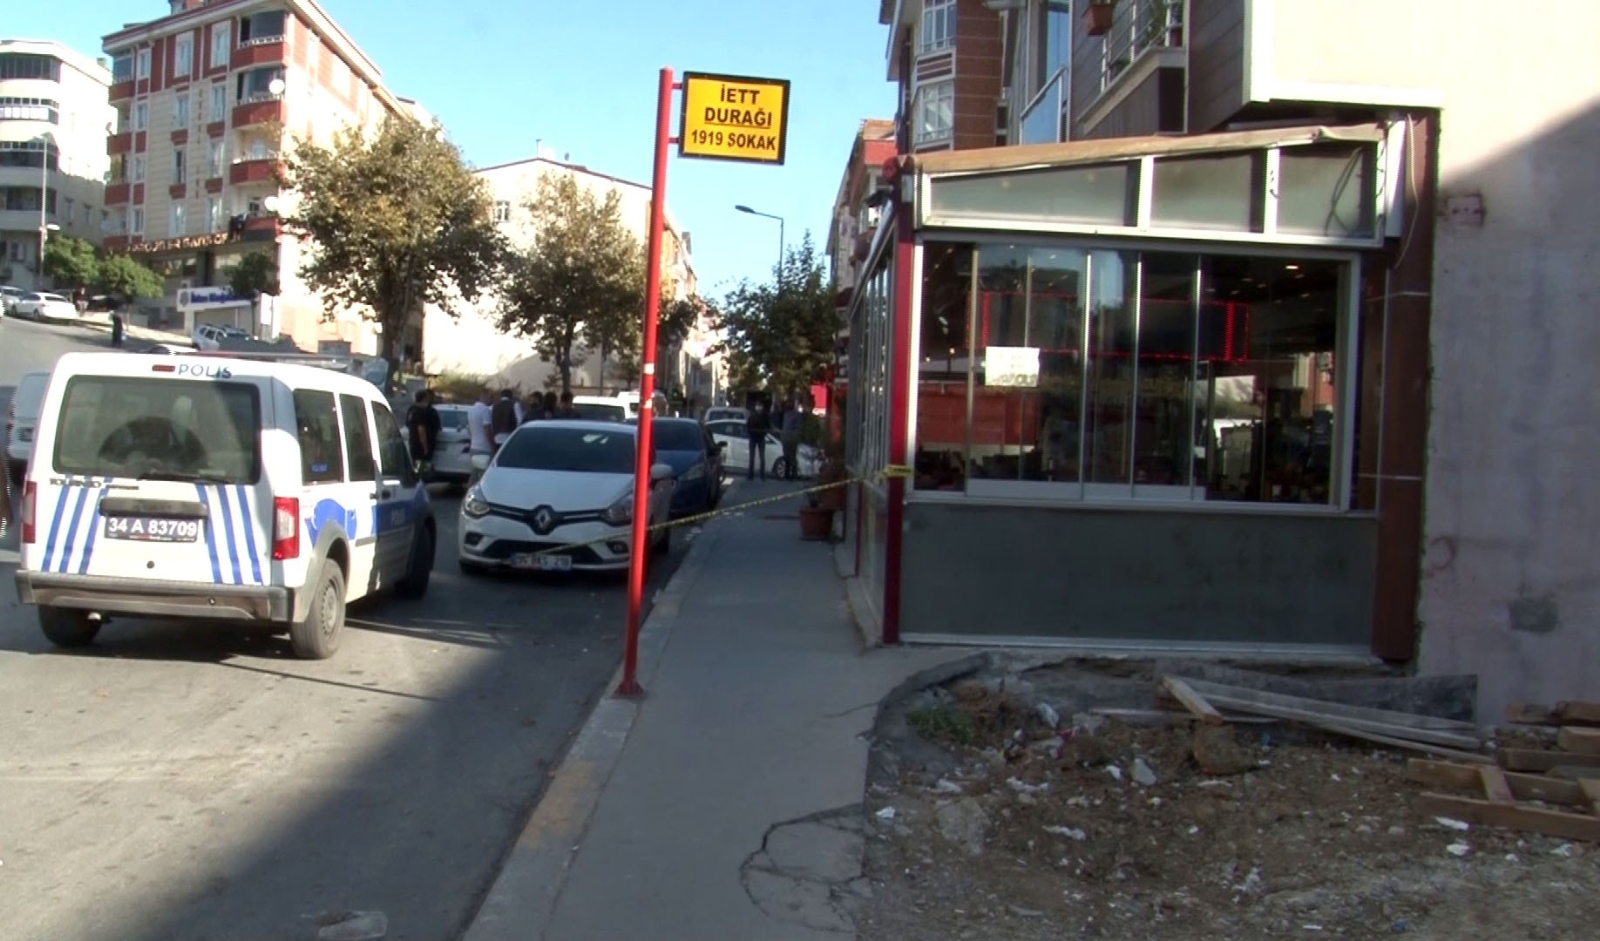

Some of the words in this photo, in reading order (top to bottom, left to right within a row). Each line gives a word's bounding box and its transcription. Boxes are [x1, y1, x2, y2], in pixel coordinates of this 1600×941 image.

[721, 84, 759, 104] İETT
[705, 107, 772, 126] DURAĞI
[692, 130, 723, 145] 1919
[728, 133, 776, 150] SOKAK
[108, 517, 128, 533] 34
[131, 519, 144, 534] A
[148, 519, 197, 537] 83709
